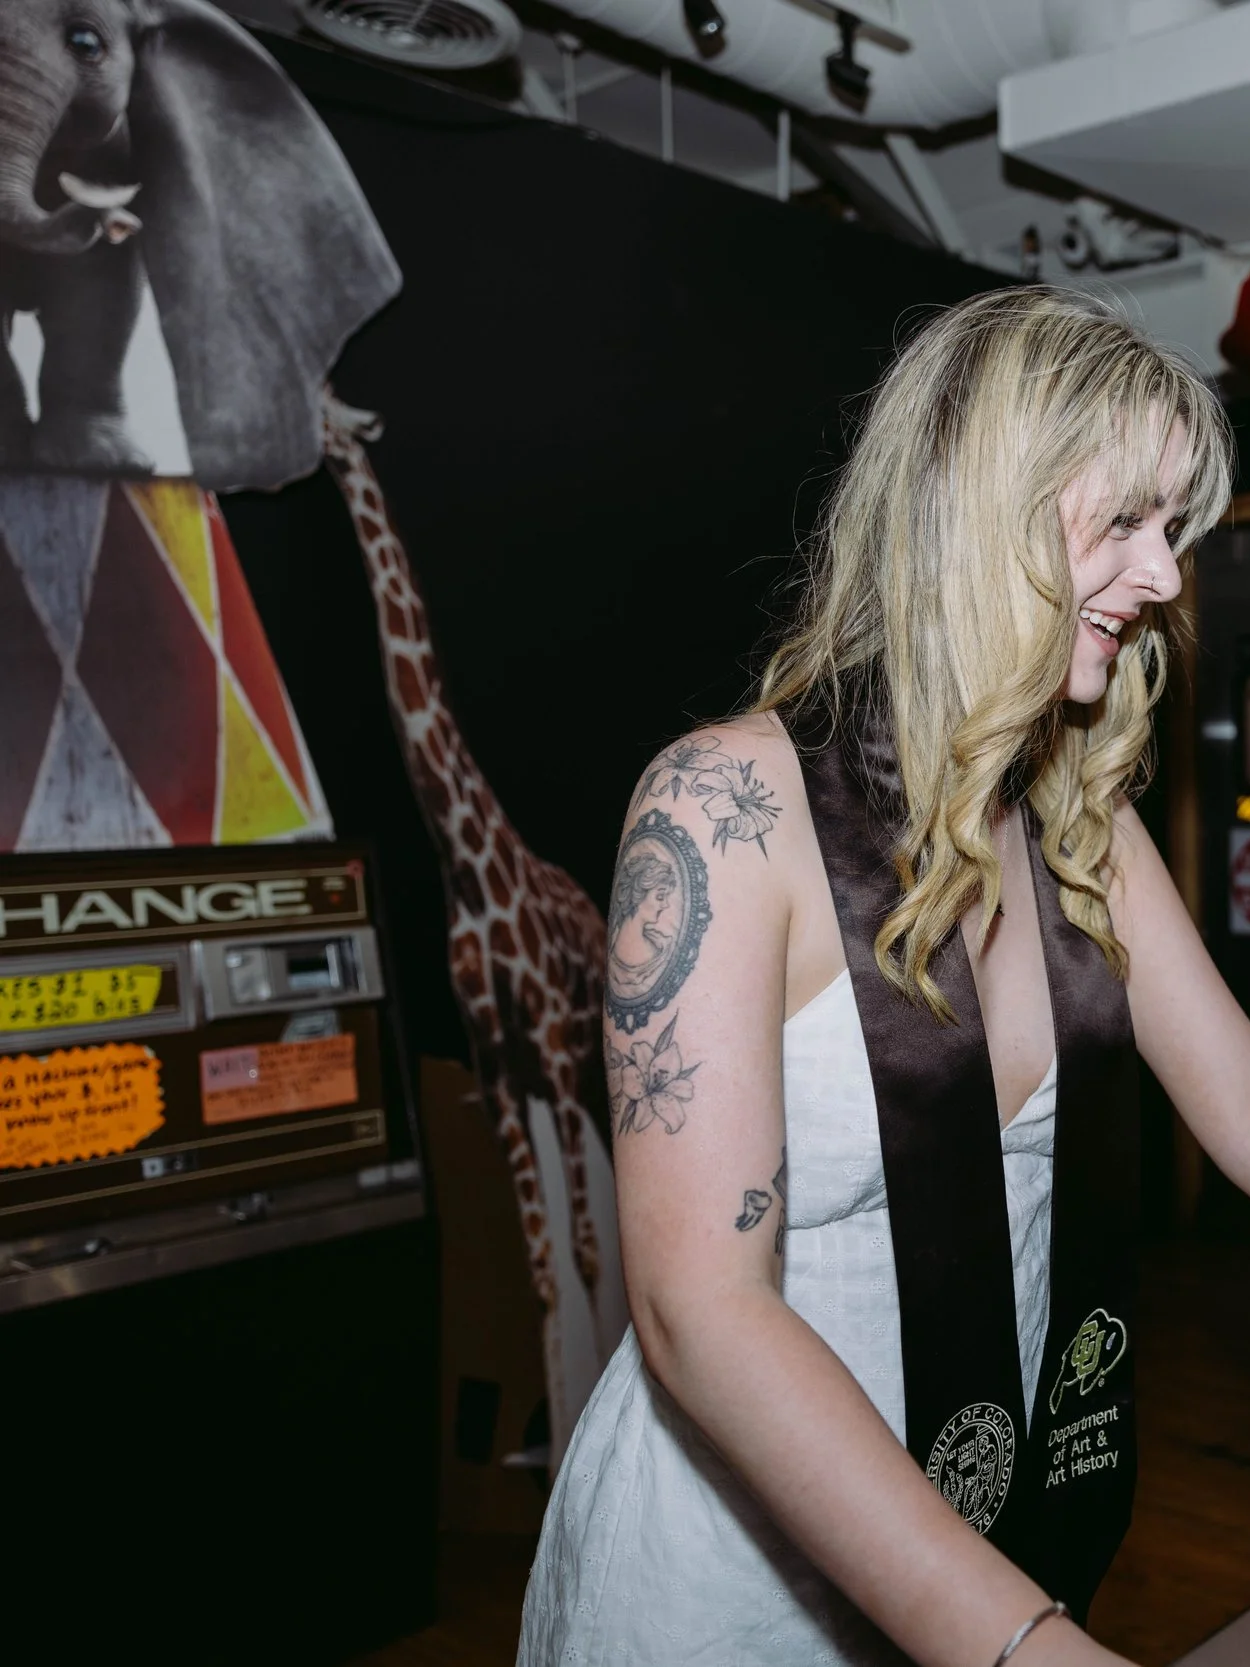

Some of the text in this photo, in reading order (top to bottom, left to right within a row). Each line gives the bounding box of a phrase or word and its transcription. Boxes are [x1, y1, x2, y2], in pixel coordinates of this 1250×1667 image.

[1047, 1405, 1119, 1448] Department
[947, 1449, 958, 1462] LET
[961, 1406, 982, 1424] OF
[985, 1407, 1012, 1496] COLORADO
[1053, 1430, 1109, 1465] of Art &
[1045, 1450, 1119, 1489] Art History
[974, 1513, 991, 1533] 76
